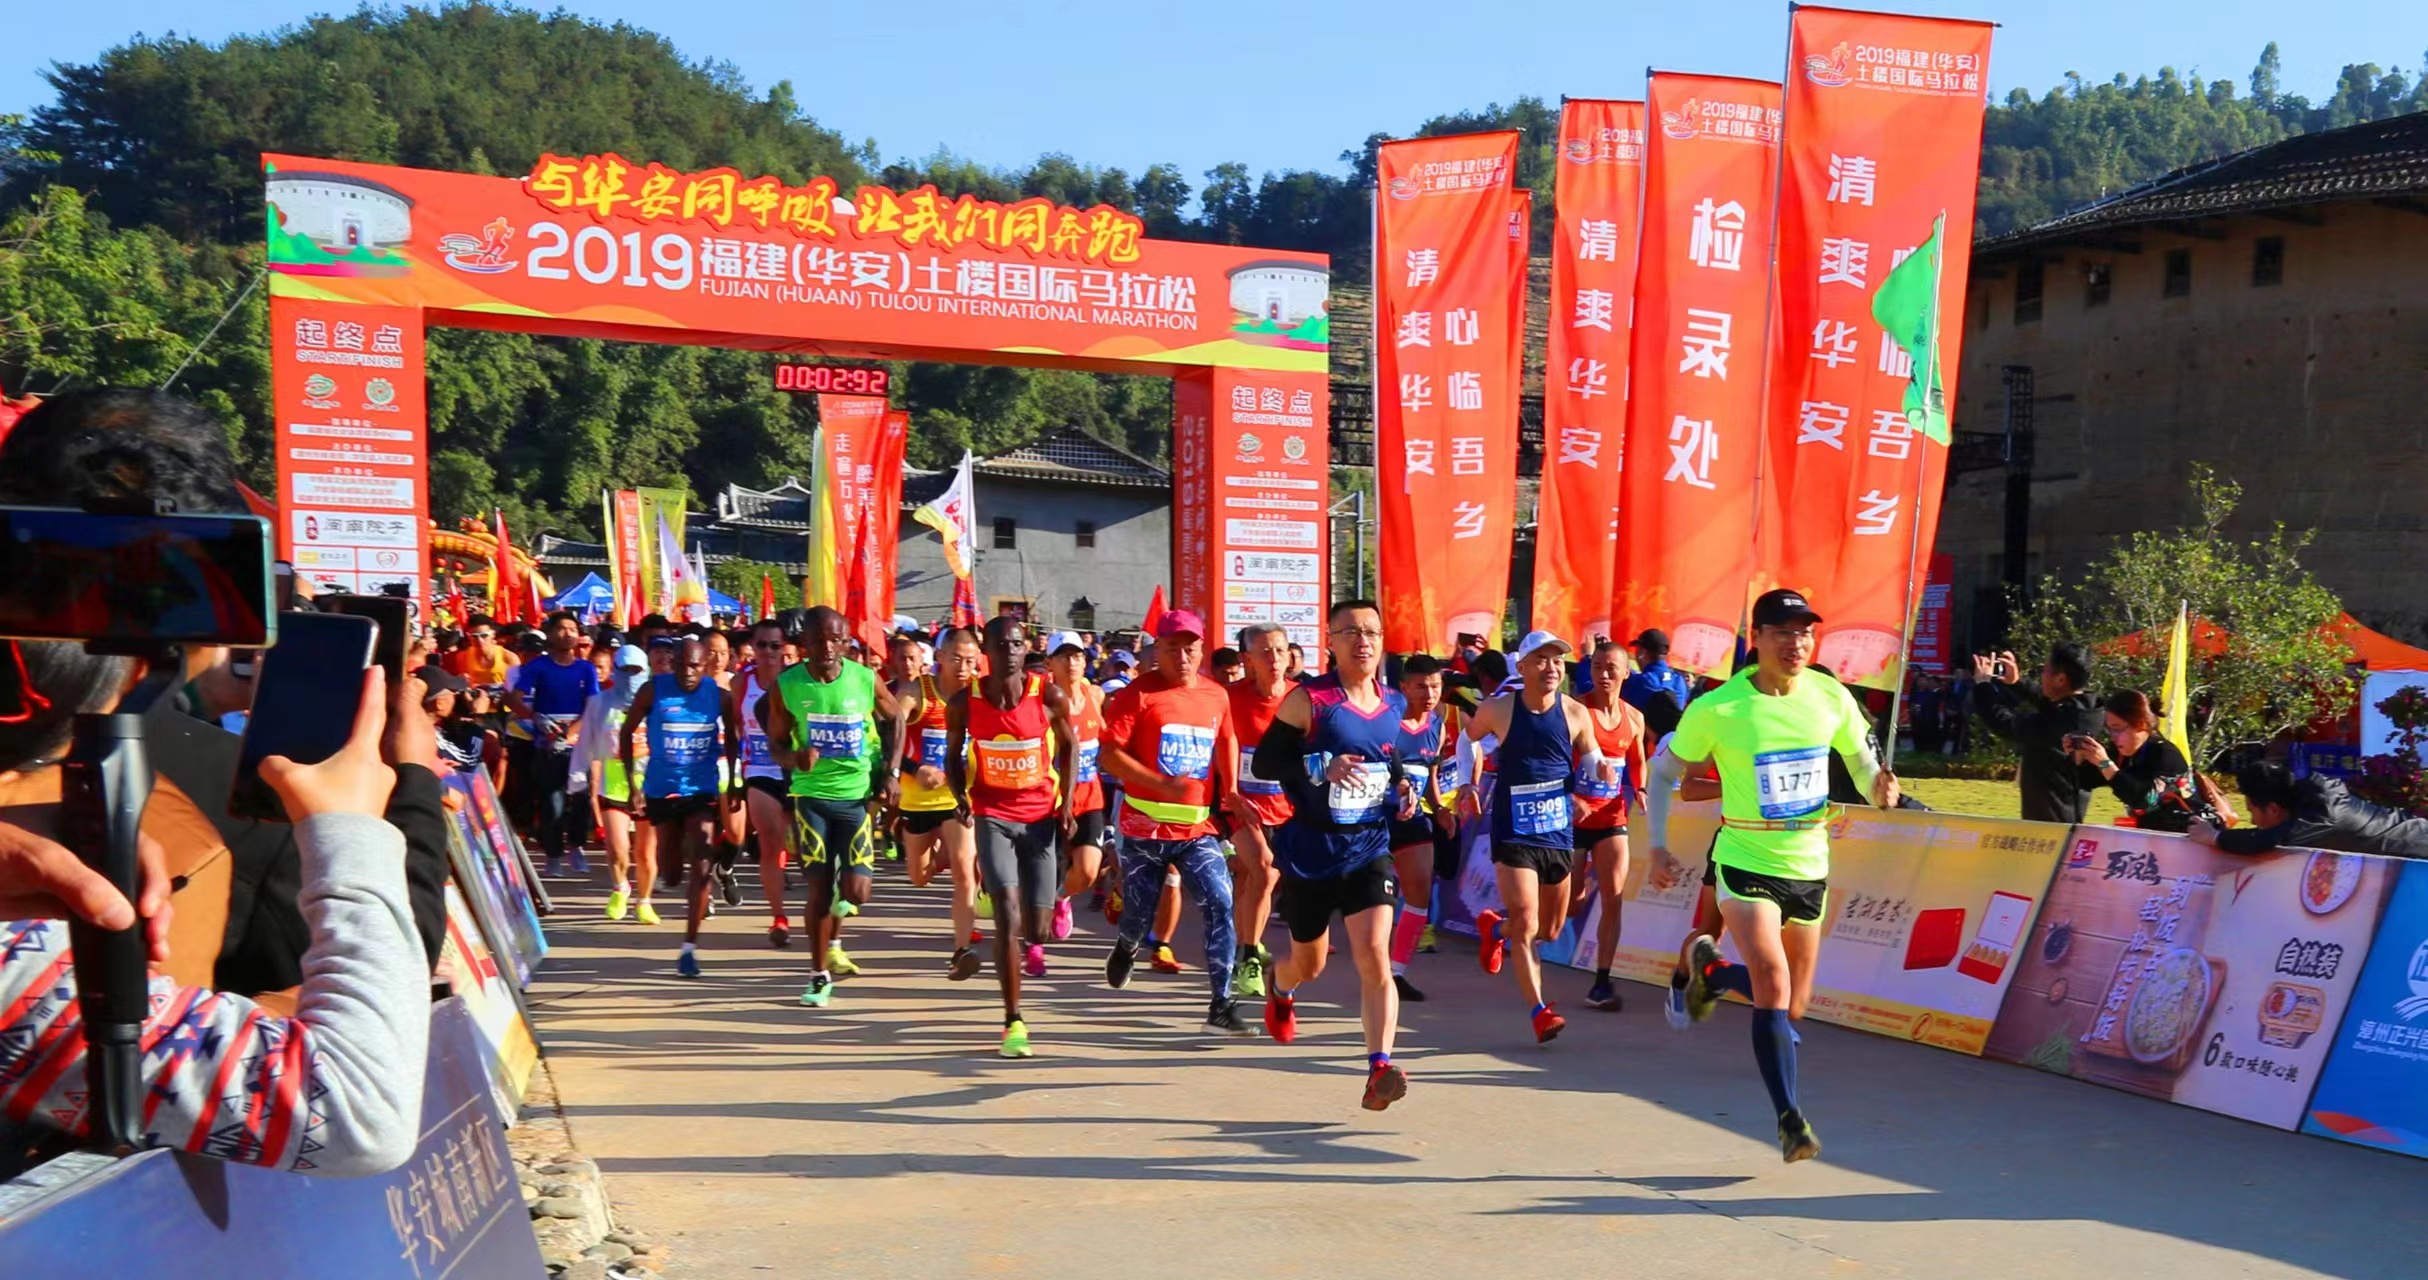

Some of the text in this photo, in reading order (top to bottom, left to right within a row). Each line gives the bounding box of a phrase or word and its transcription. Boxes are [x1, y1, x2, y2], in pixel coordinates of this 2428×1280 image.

[530, 158, 1143, 262] 与华安同呼吸 让我们同奔跑
[526, 221, 1198, 313] 2019 福建(华安)土楼国际马拉松
[700, 276, 1198, 332] FUJIAN (HUAAN) TULOU INTERNATIONAL MARATHON
[1797, 153, 1877, 450] 清爽华安
[296, 318, 403, 353] 起终点
[1559, 217, 1617, 470] 清爽华安
[1664, 197, 1746, 490] 检录处
[1396, 248, 1439, 476] 清爽华安
[1232, 385, 1313, 414] 起终点
[1444, 307, 1487, 541] 心临吾乡
[663, 736, 711, 750] M1487
[810, 728, 862, 743] M1488
[986, 755, 1037, 771] F0108
[1777, 770, 1822, 793] 1777
[1516, 795, 1564, 816] T3909
[2275, 937, 2343, 980] 自热装
